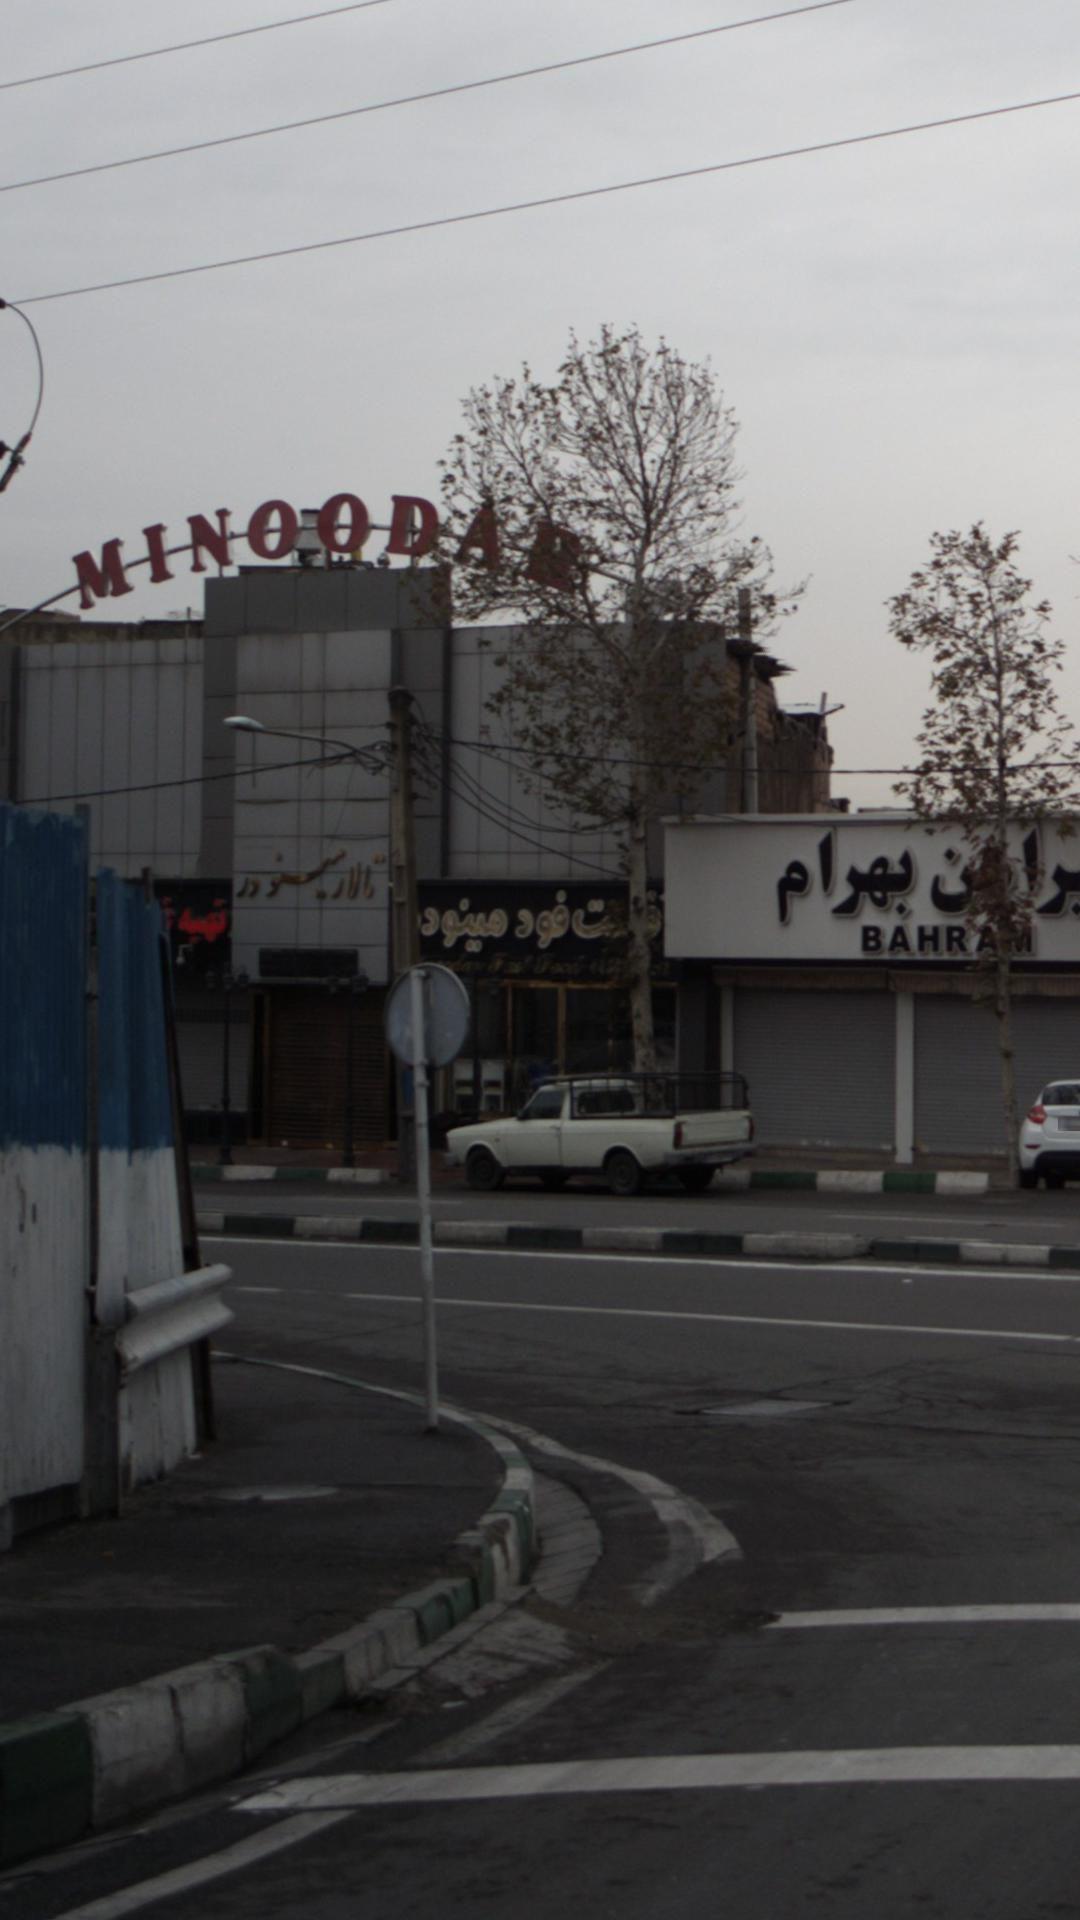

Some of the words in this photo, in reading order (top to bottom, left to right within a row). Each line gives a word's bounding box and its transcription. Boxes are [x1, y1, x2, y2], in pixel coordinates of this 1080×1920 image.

[72, 493, 588, 610] MINOODAR
[777, 830, 914, 923] بهرام
[417, 898, 508, 952] مینود
[515, 889, 570, 949] فود
